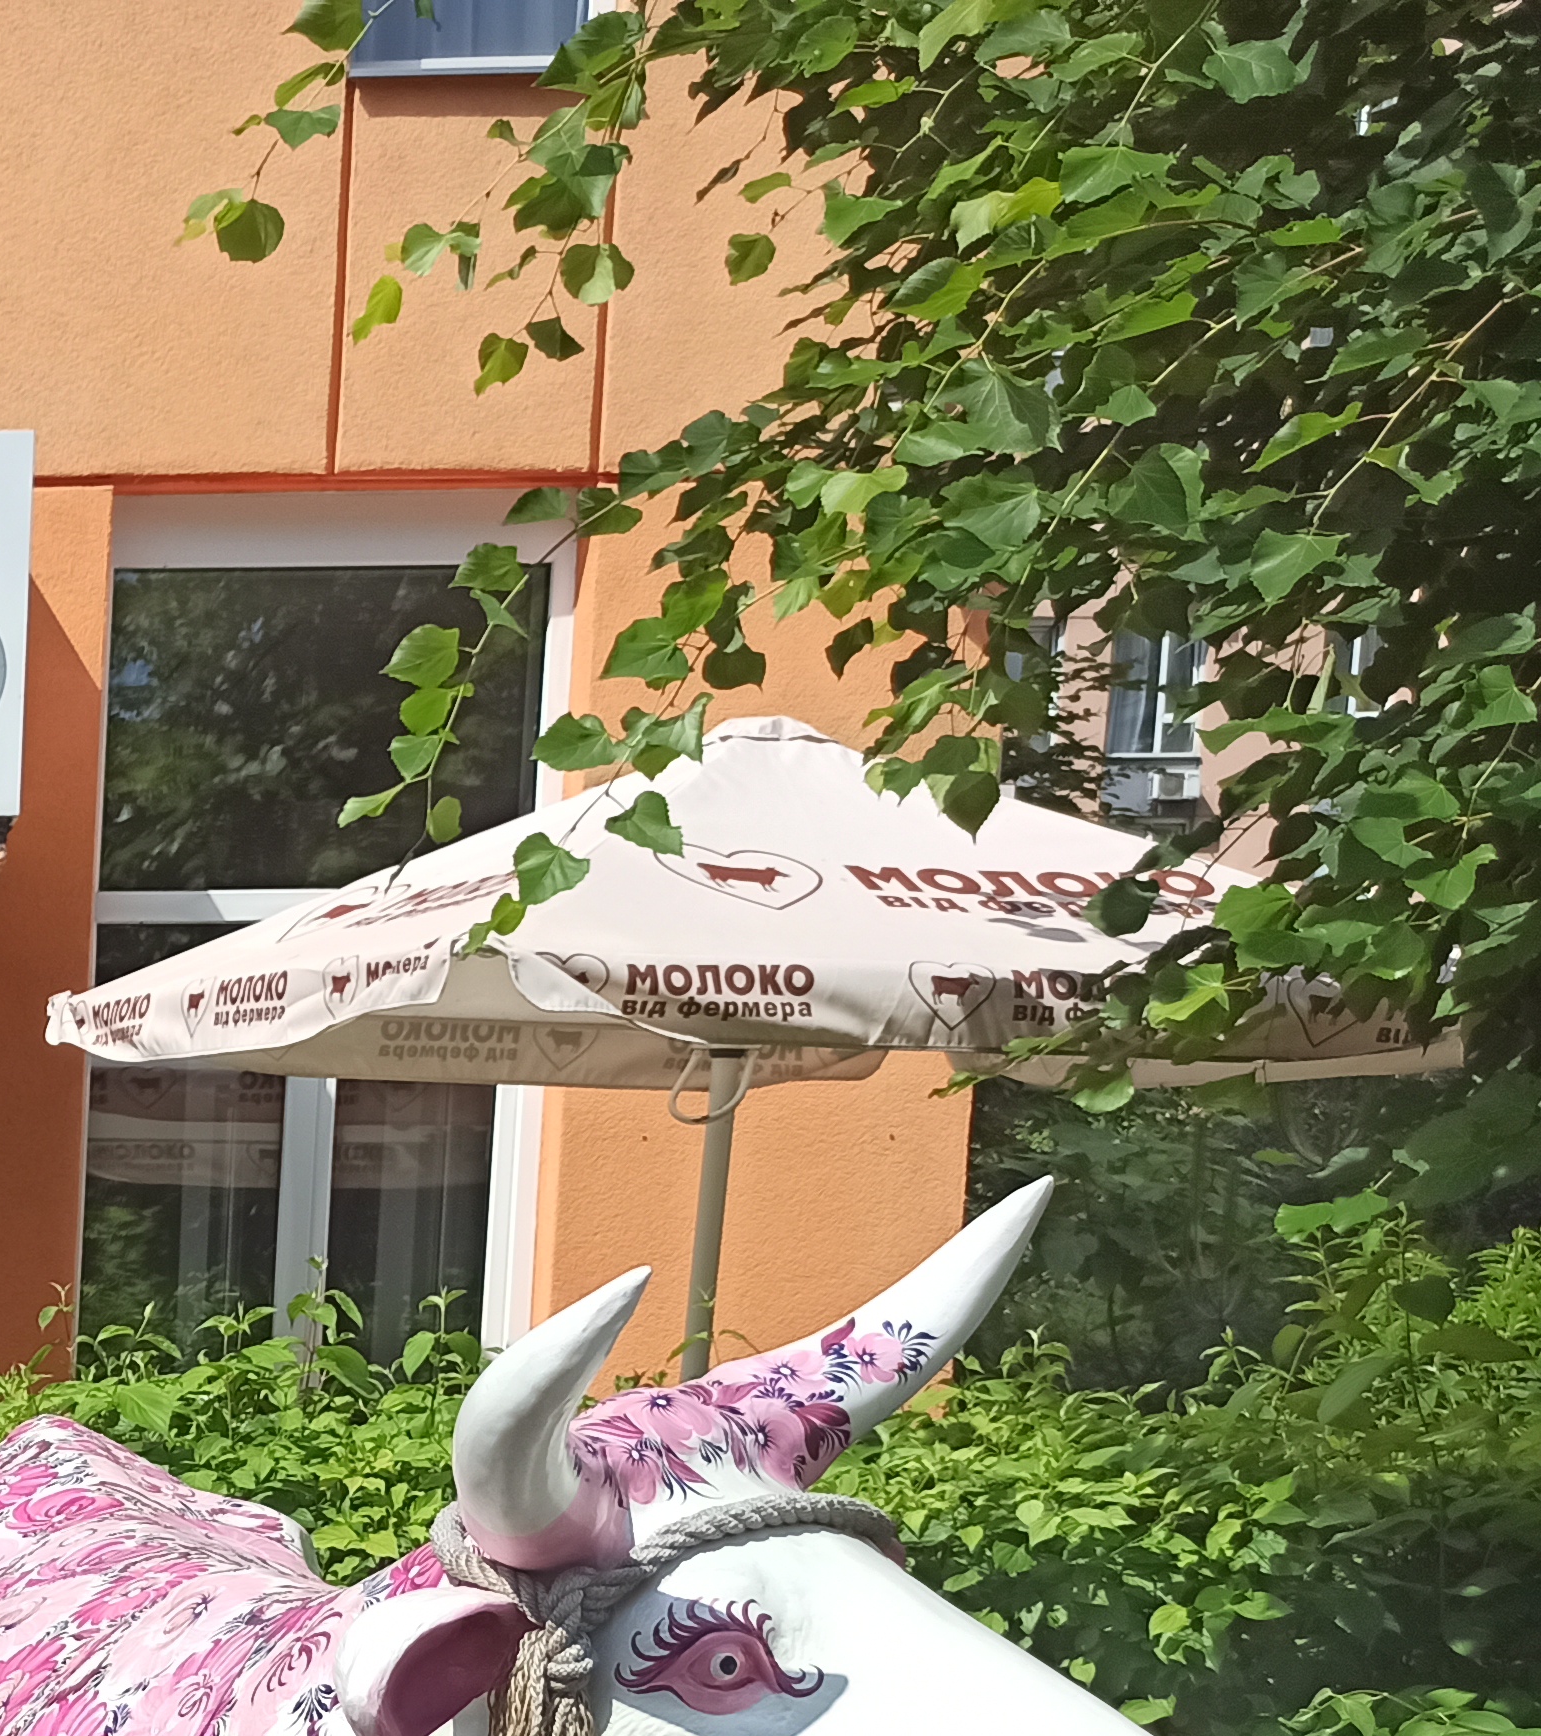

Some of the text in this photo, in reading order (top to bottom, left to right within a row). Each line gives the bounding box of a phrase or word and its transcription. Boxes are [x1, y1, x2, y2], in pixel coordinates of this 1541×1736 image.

[844, 864, 1216, 899] МОЛОО
[877, 895, 969, 913] від
[215, 969, 289, 1007] МОЛОКО
[624, 963, 815, 997] МОЛОКО
[91, 992, 152, 1031] МОЛОКО
[621, 996, 813, 1022] від фермера
[1012, 1004, 1055, 1027] від
